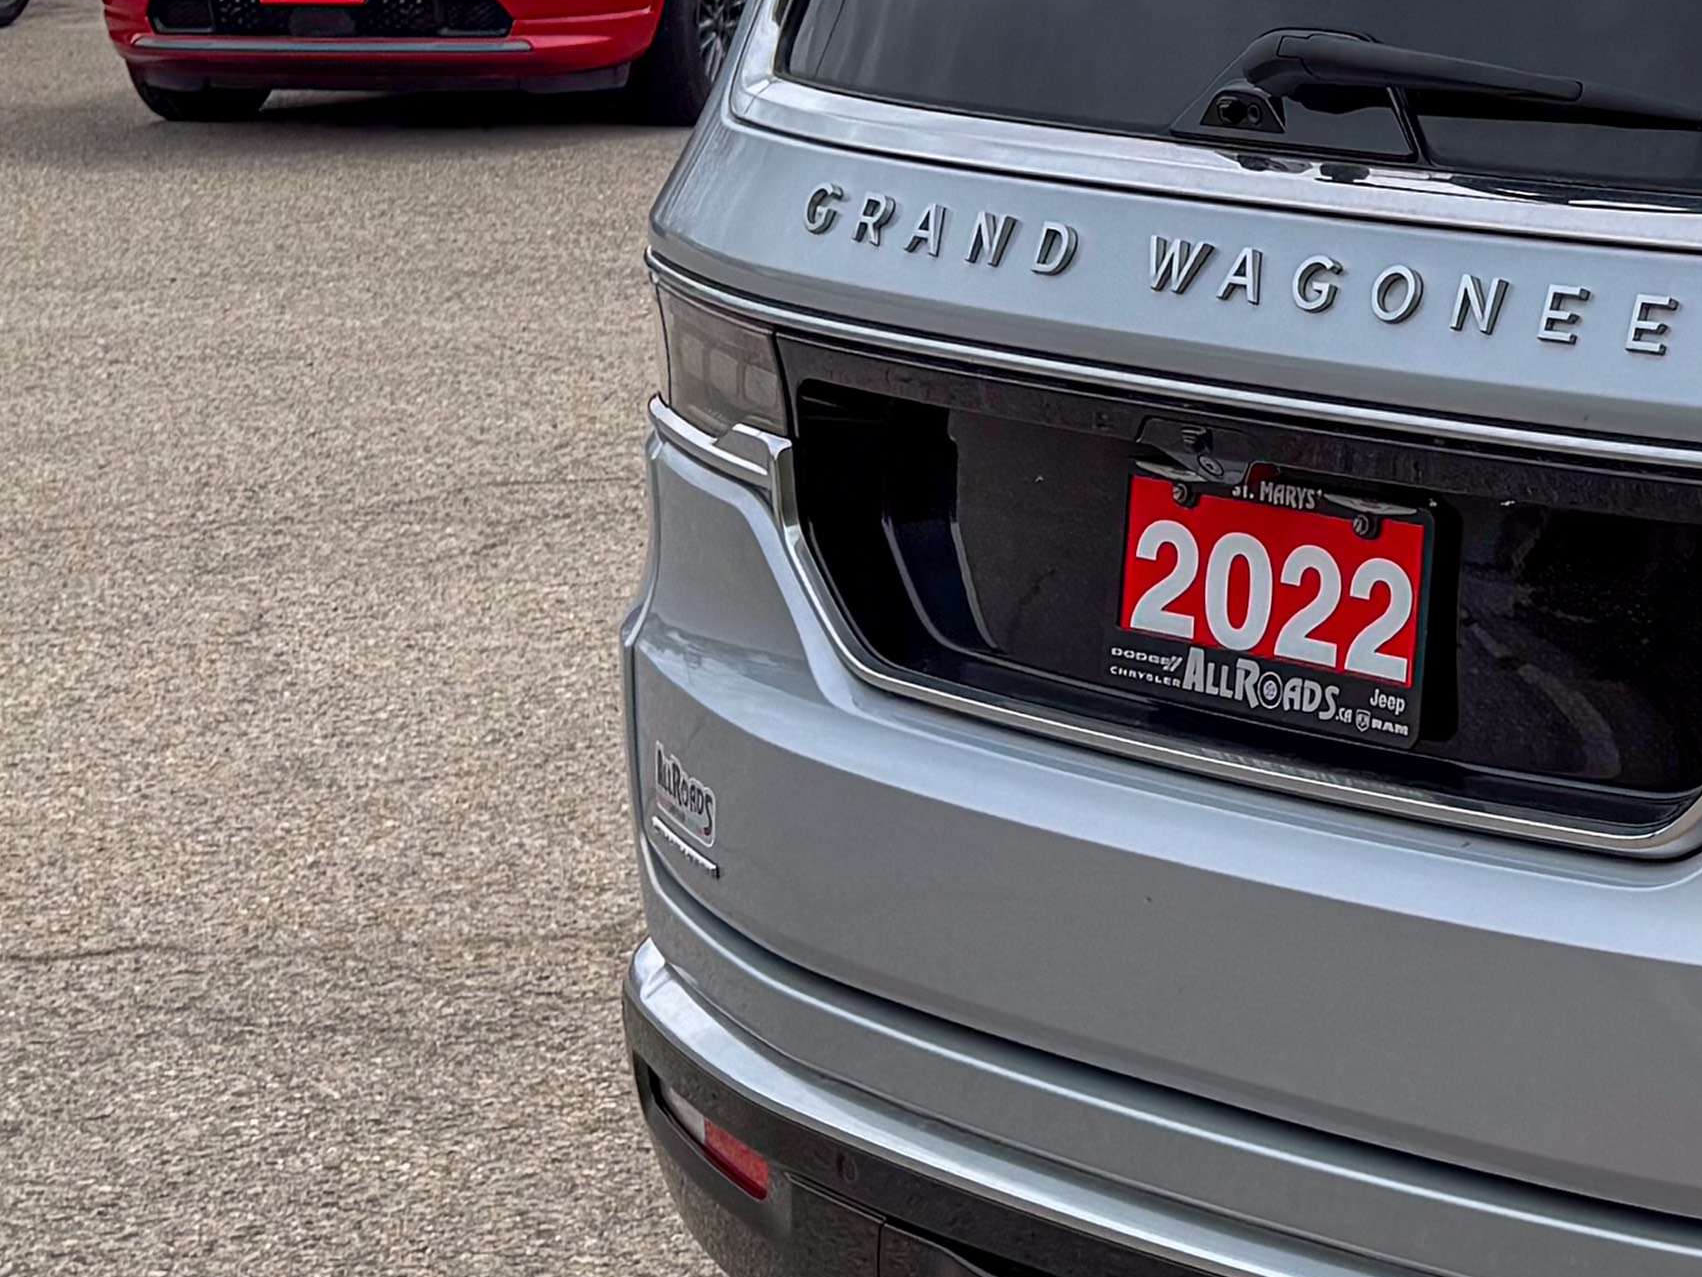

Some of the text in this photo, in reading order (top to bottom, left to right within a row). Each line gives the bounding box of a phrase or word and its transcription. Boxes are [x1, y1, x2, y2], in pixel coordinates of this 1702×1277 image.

[800, 180, 1080, 277] GRAND
[1129, 519, 1413, 684] 2022
[1110, 646, 1170, 666] DODGE
[1109, 665, 1182, 689] CHRYSLER
[1369, 688, 1406, 716] Jeep
[1371, 717, 1409, 737] RAM
